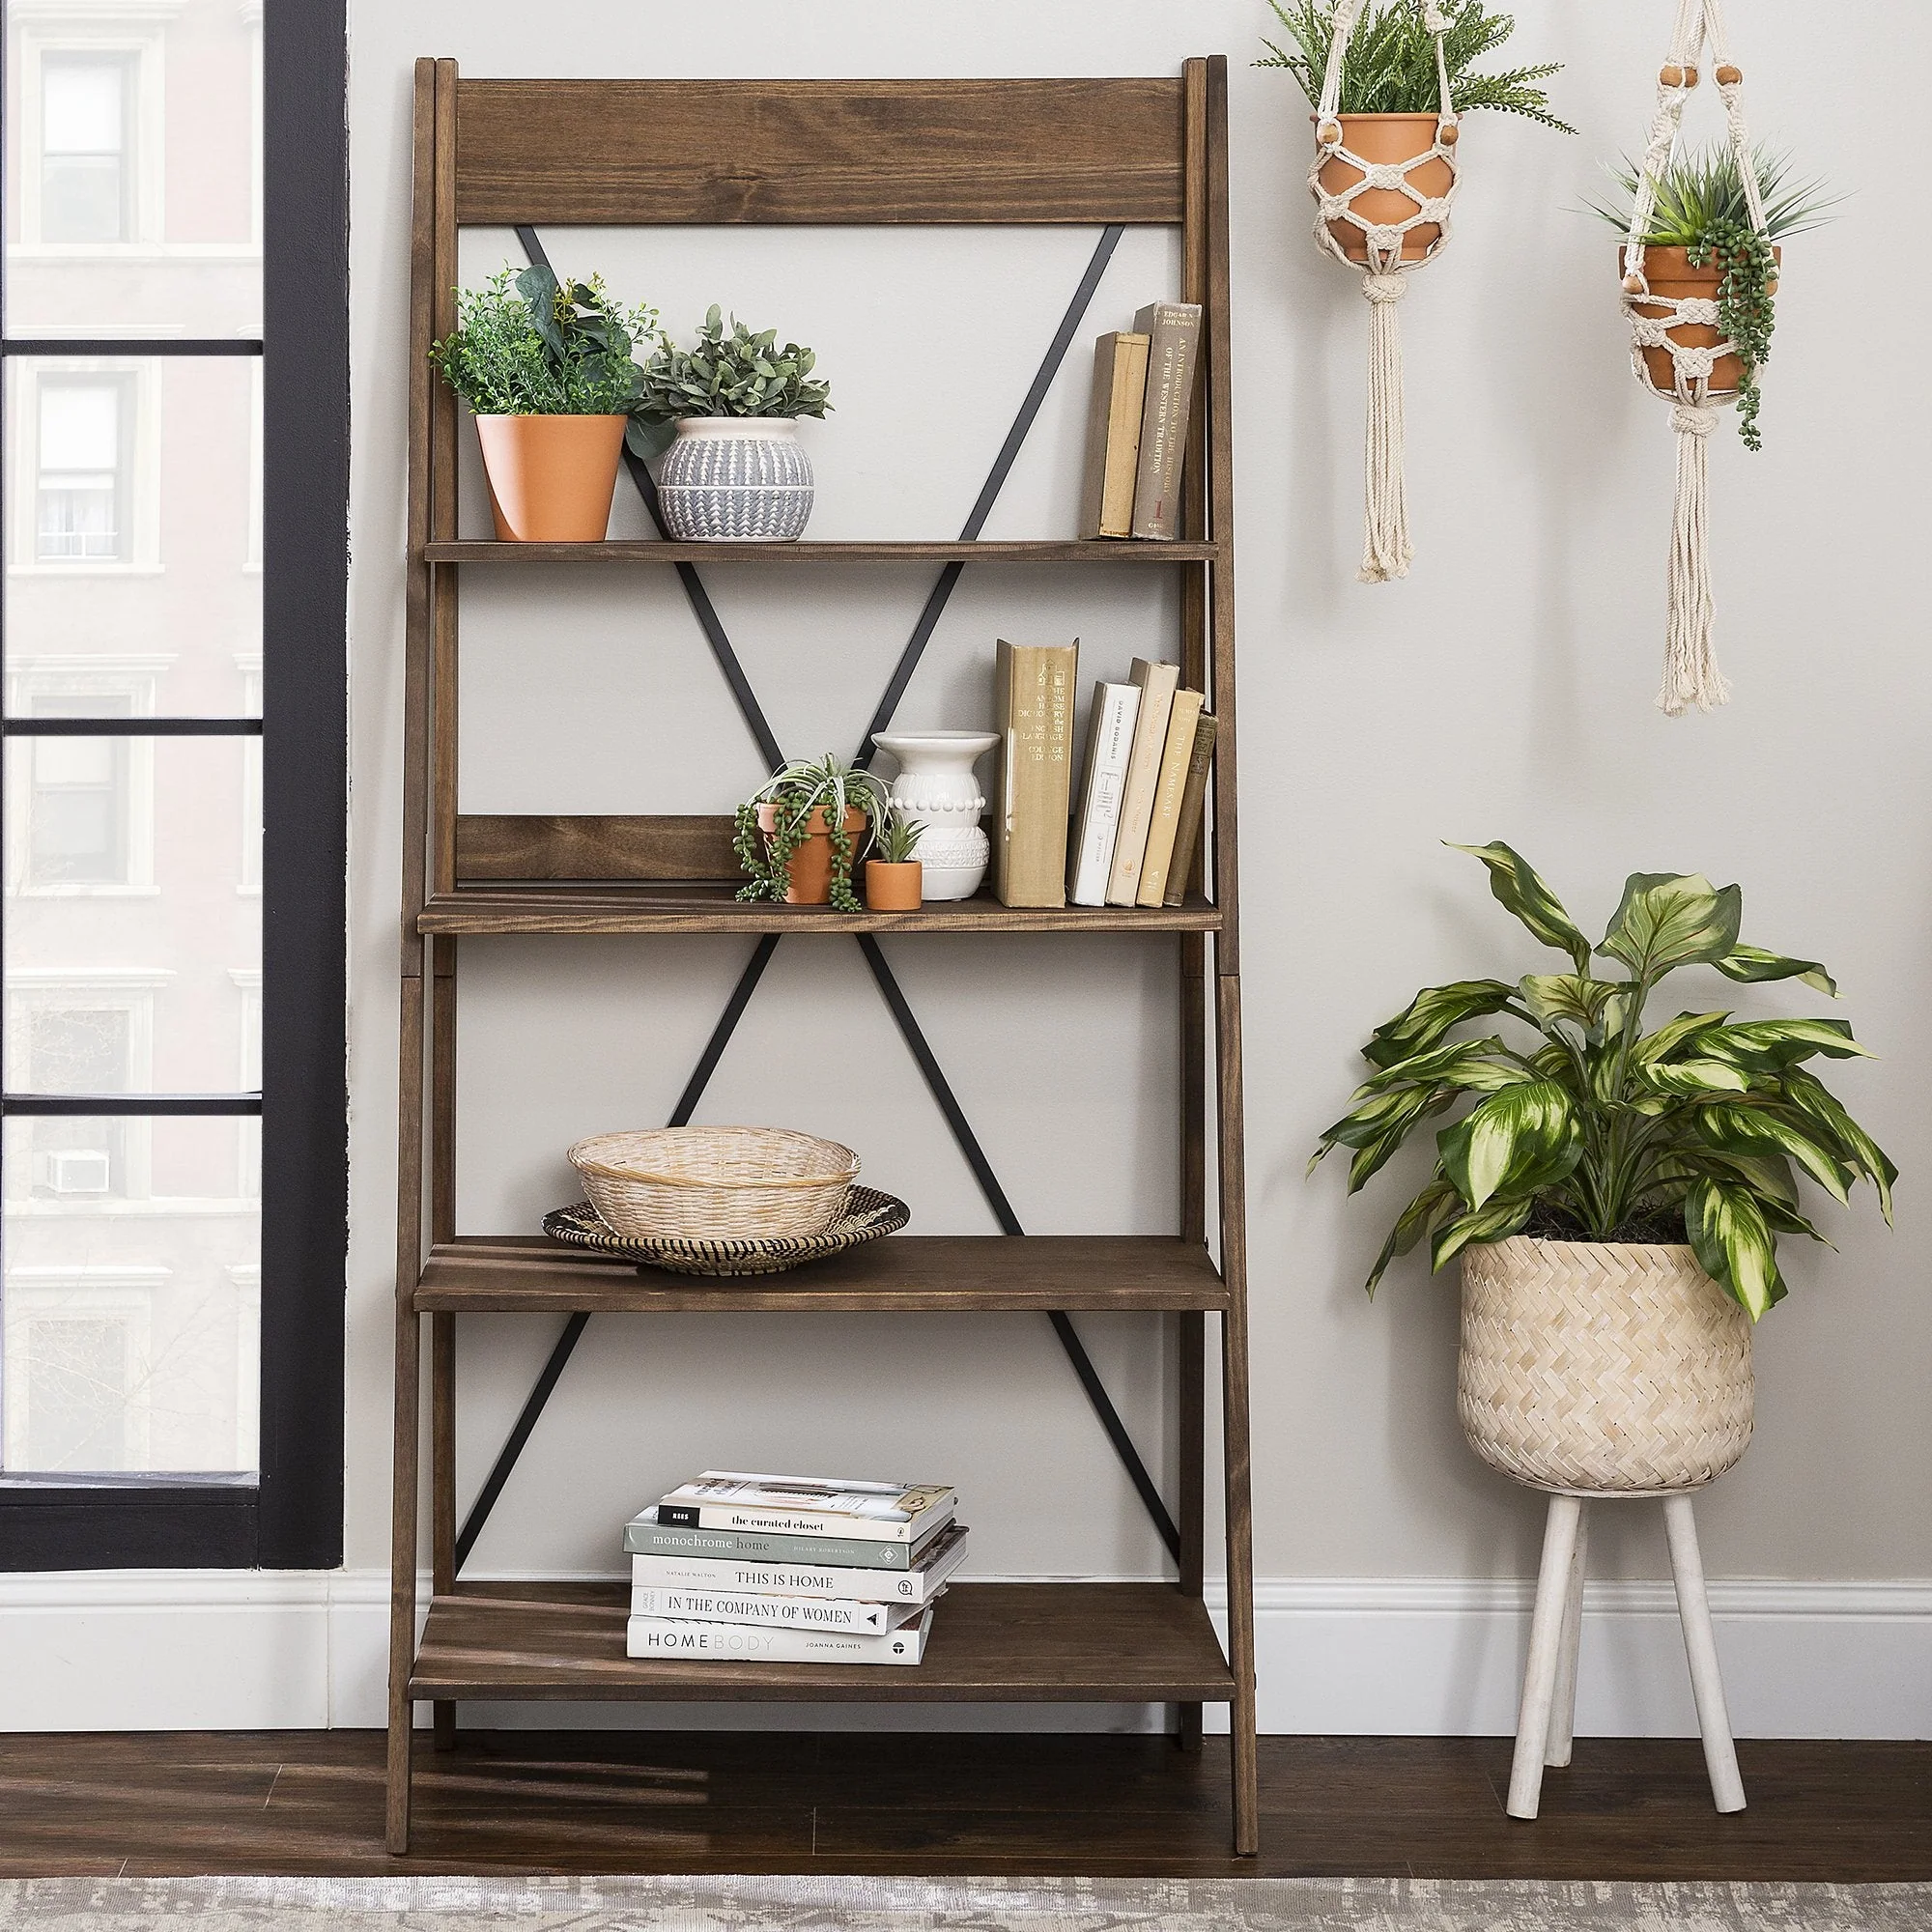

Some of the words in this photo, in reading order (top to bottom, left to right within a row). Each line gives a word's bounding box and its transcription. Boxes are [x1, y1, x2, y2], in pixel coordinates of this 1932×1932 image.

[1161, 318, 1195, 327] JOHNSON
[1165, 347, 1174, 358] OF
[1179, 337, 1186, 350] AN
[1162, 360, 1172, 380] THE
[1171, 354, 1185, 418] INTRODUCTION
[1158, 383, 1170, 423] WESTERN
[1152, 425, 1165, 474] TRADITION
[1110, 726, 1122, 760] BODANIS
[1173, 734, 1186, 757] THE
[1162, 761, 1180, 818] NAMESAKE
[731, 1515, 749, 1525] the
[751, 1518, 791, 1529] curated
[793, 1520, 824, 1531] closet
[653, 1534, 733, 1548] monochrome
[735, 1537, 770, 1550] home
[734, 1571, 769, 1584] THIS
[774, 1574, 785, 1586] IS
[789, 1575, 834, 1589] HOME
[668, 1596, 682, 1609] IN
[686, 1597, 713, 1612] THE
[716, 1600, 779, 1618] COMPANY
[781, 1605, 800, 1619] OF
[803, 1607, 852, 1624] WOMEN
[648, 1633, 774, 1651] HOMEBODY
